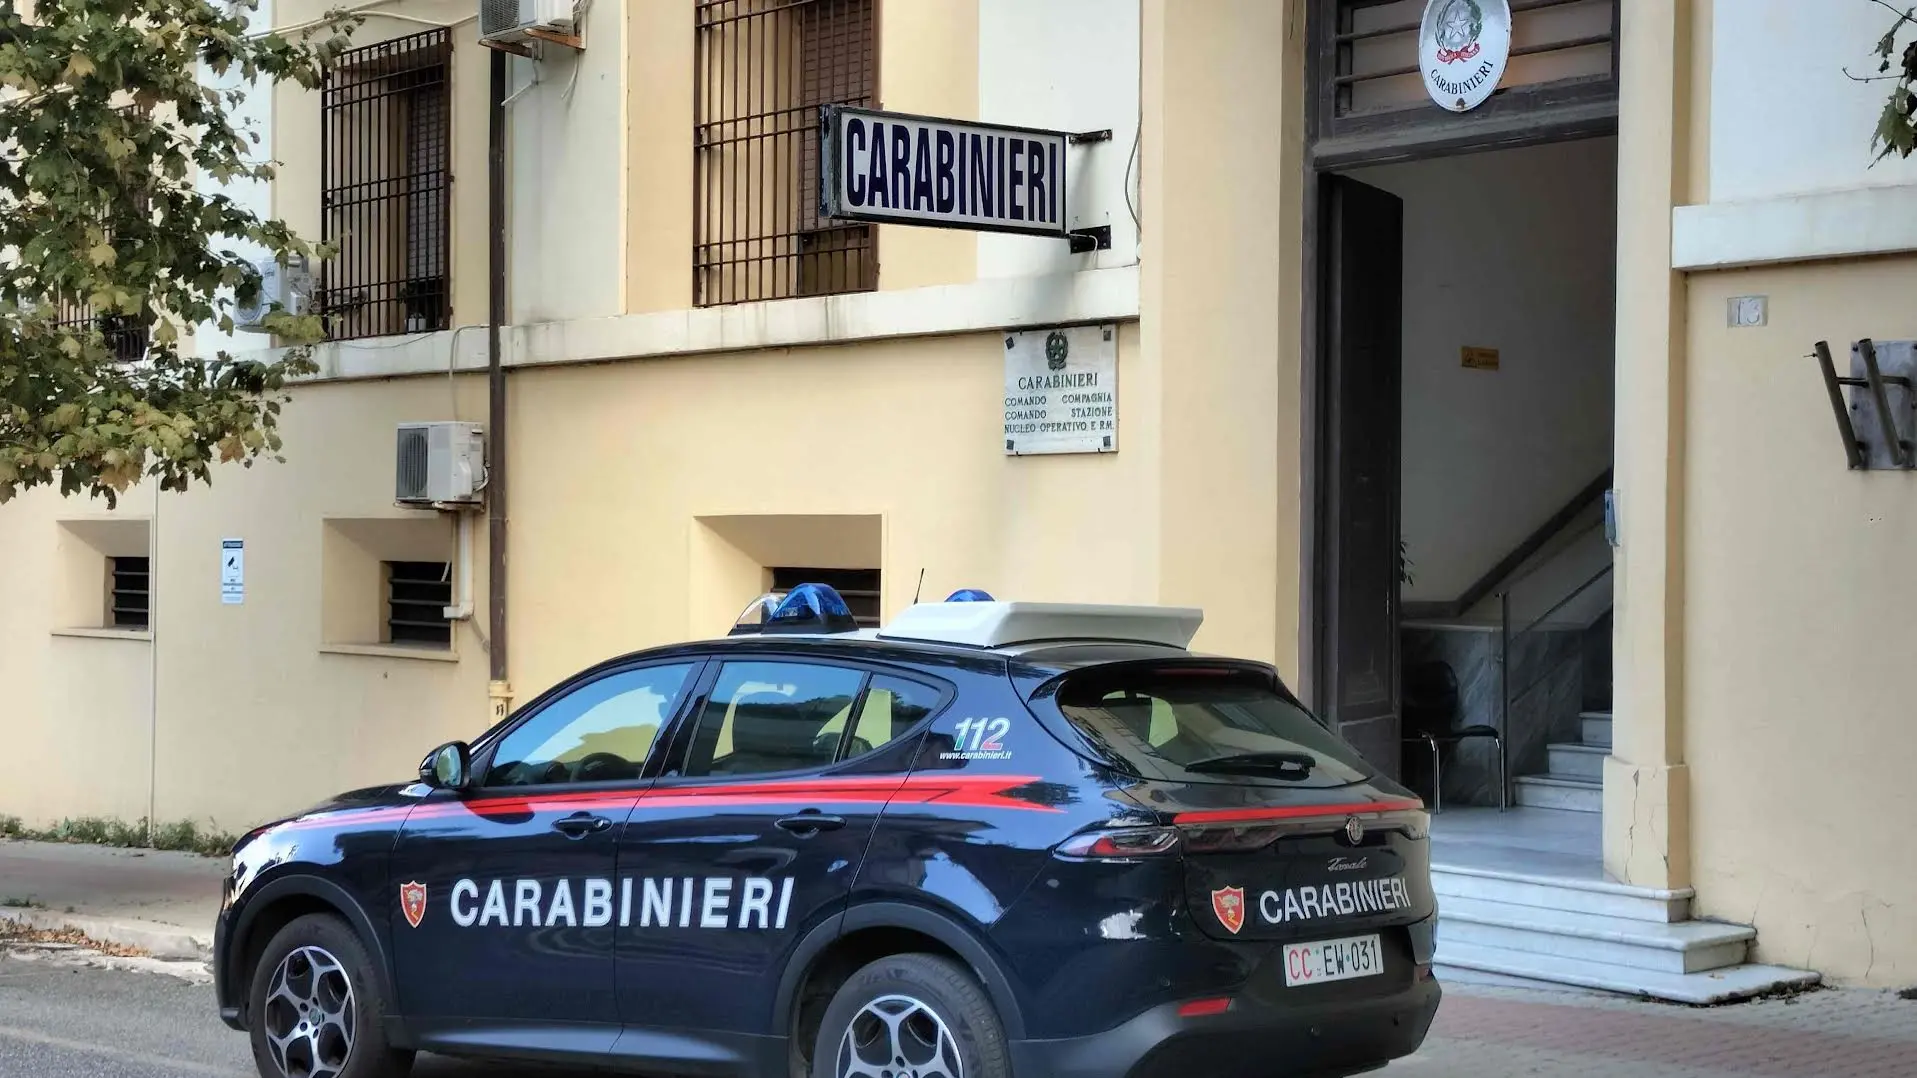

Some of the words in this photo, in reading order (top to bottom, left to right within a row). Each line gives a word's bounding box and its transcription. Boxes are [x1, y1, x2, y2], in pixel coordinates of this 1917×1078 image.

[1430, 60, 1494, 95] CARABINIERI
[846, 118, 1057, 224] CARABINIERI
[1018, 372, 1098, 390] CARABINIERI
[1004, 395, 1047, 407] COMANDO
[1061, 392, 1113, 404] COMPAGNIA
[1004, 409, 1047, 421] COMANDO
[1071, 406, 1113, 418] STAZIONE
[1004, 423, 1036, 434] NUCLEO
[1040, 421, 1087, 433] OPERATIVO
[1090, 421, 1097, 430] E
[954, 717, 1011, 751] 112
[939, 751, 1012, 760] www.carabinieri.it
[450, 877, 795, 929] CARABINIERI
[1259, 878, 1411, 924] CARABINIERI
